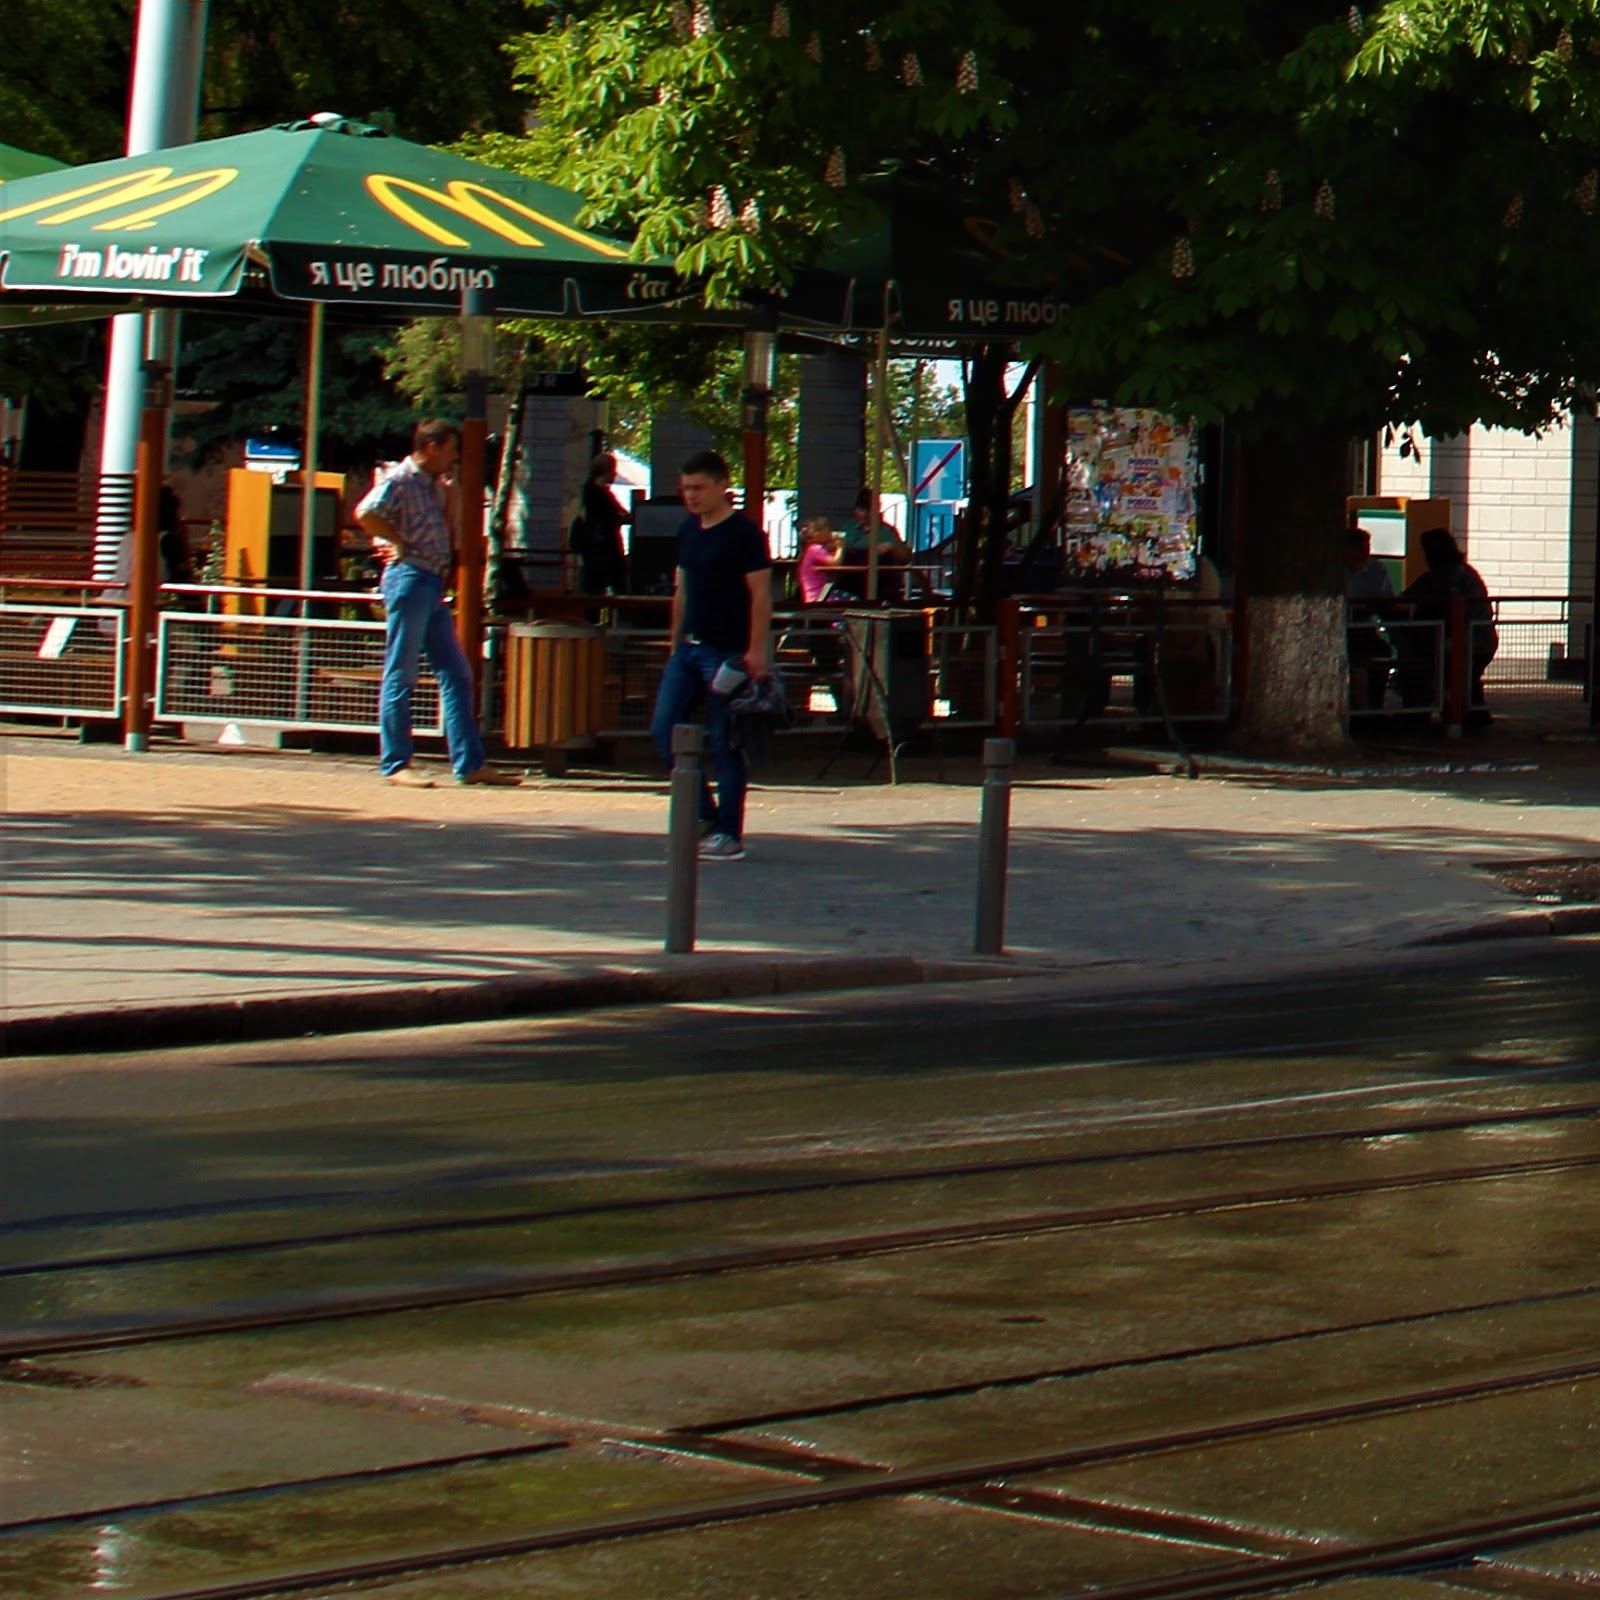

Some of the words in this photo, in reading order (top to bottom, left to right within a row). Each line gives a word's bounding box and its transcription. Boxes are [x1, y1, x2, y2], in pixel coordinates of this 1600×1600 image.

[59, 244, 101, 277] i'm
[104, 244, 182, 281] lovin'
[180, 247, 205, 282] it
[310, 261, 330, 286] я
[334, 261, 375, 292] це
[381, 257, 495, 292] люблю
[949, 299, 963, 321] я
[969, 300, 999, 326] це
